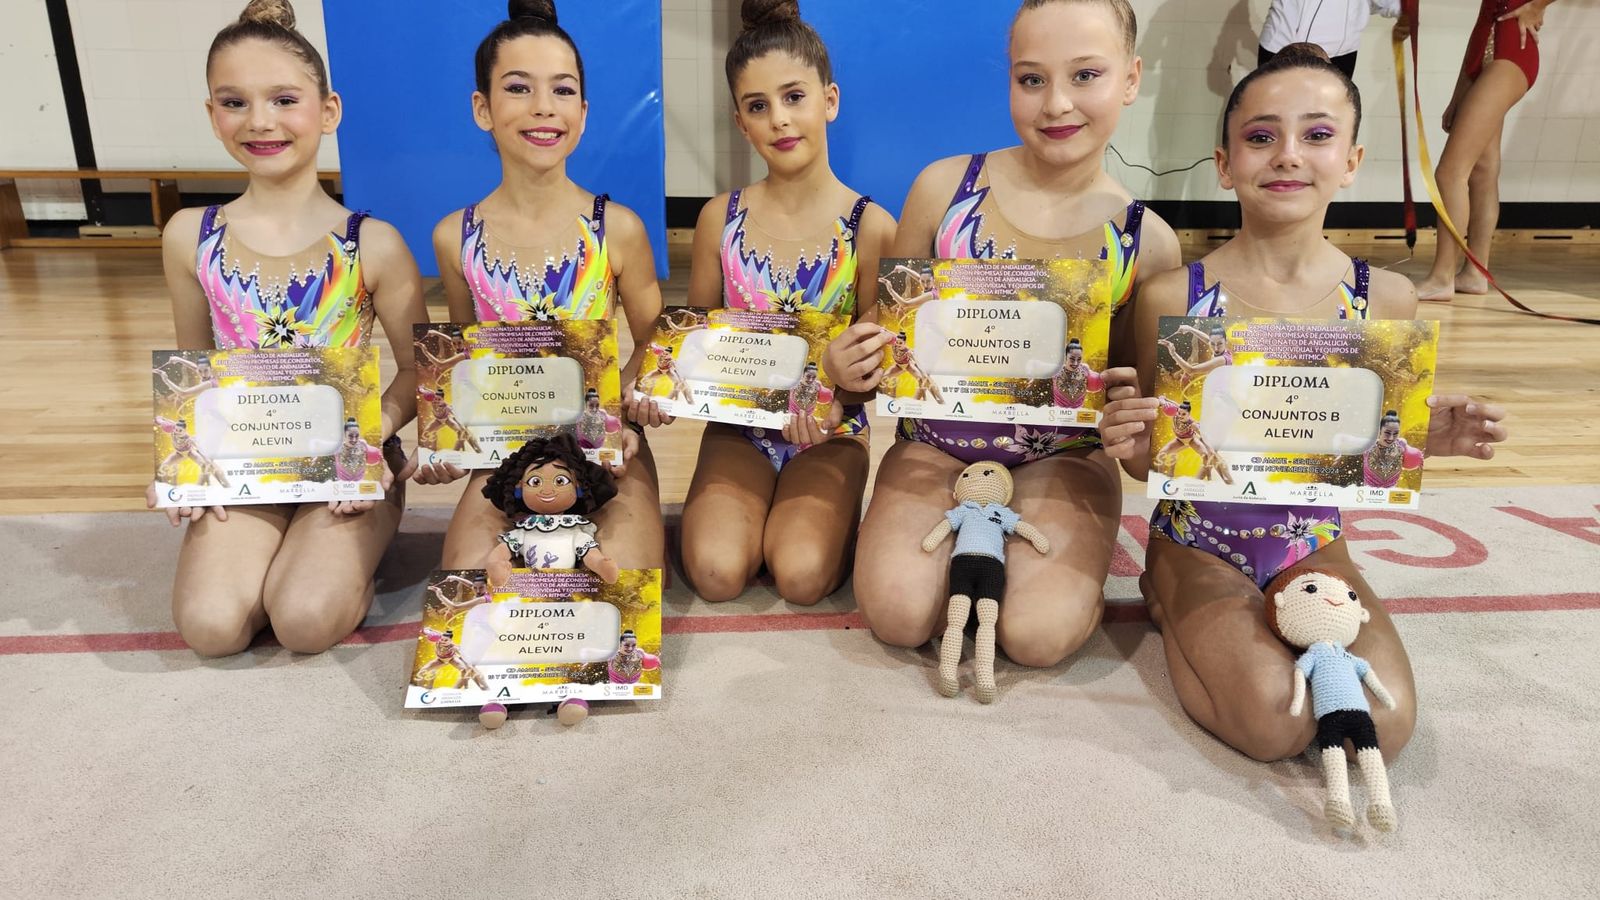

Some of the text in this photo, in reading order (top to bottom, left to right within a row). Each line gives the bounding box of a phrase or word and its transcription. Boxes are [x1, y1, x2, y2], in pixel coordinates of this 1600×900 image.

[957, 308, 1021, 320] DIPLOMA
[719, 334, 772, 346] DIPLOMA
[949, 338, 1031, 349] CONJUNTOS B
[707, 354, 777, 368] CONJUNTOS B
[968, 355, 1010, 364] ALEVIN
[487, 364, 545, 376] DIPLOMA
[721, 367, 757, 377] ALEVIN
[1253, 375, 1330, 389] DIPLOMA
[237, 393, 301, 405] DIPLOMA
[482, 391, 555, 401] CONJUNTOS B
[500, 405, 538, 415] ALEVIN
[1242, 409, 1340, 422] CONJUNTOS B
[230, 421, 312, 432] CONJUNTOS B
[1264, 428, 1314, 439] ALEVIN
[251, 436, 293, 446] ALEVIN
[510, 608, 576, 618] DIPLOMA
[499, 632, 574, 641] CONJUNTOS
[519, 645, 564, 654] ALEVIN
